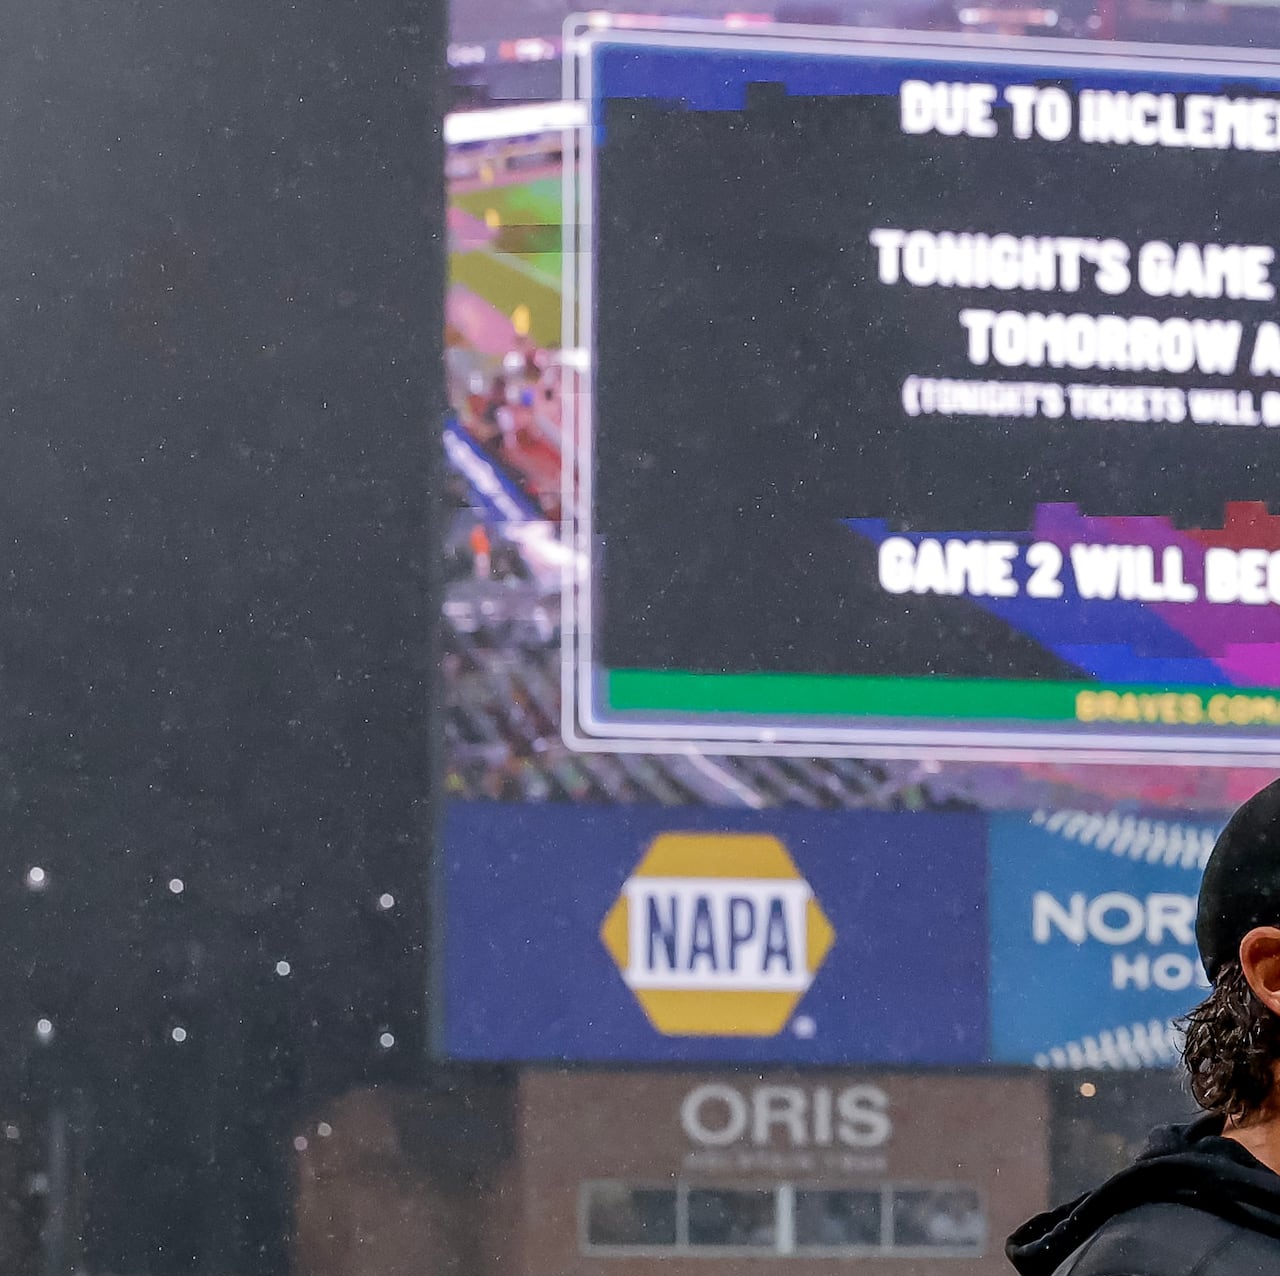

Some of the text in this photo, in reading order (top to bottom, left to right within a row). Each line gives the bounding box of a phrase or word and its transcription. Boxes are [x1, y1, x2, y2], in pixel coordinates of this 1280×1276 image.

[901, 81, 997, 136] DUE
[1004, 85, 1072, 140] TO
[870, 228, 1131, 294] TONIGHT'S
[1138, 240, 1275, 301] GAME
[959, 309, 1241, 374] TOMORROW
[1068, 383, 1187, 423] TICKETS
[1189, 389, 1260, 426] WILL
[878, 537, 1019, 596] GAME
[1026, 541, 1063, 598] 2
[1070, 544, 1198, 602] WILL
[643, 895, 794, 973] NAPA
[681, 1083, 892, 1147] ORIS
